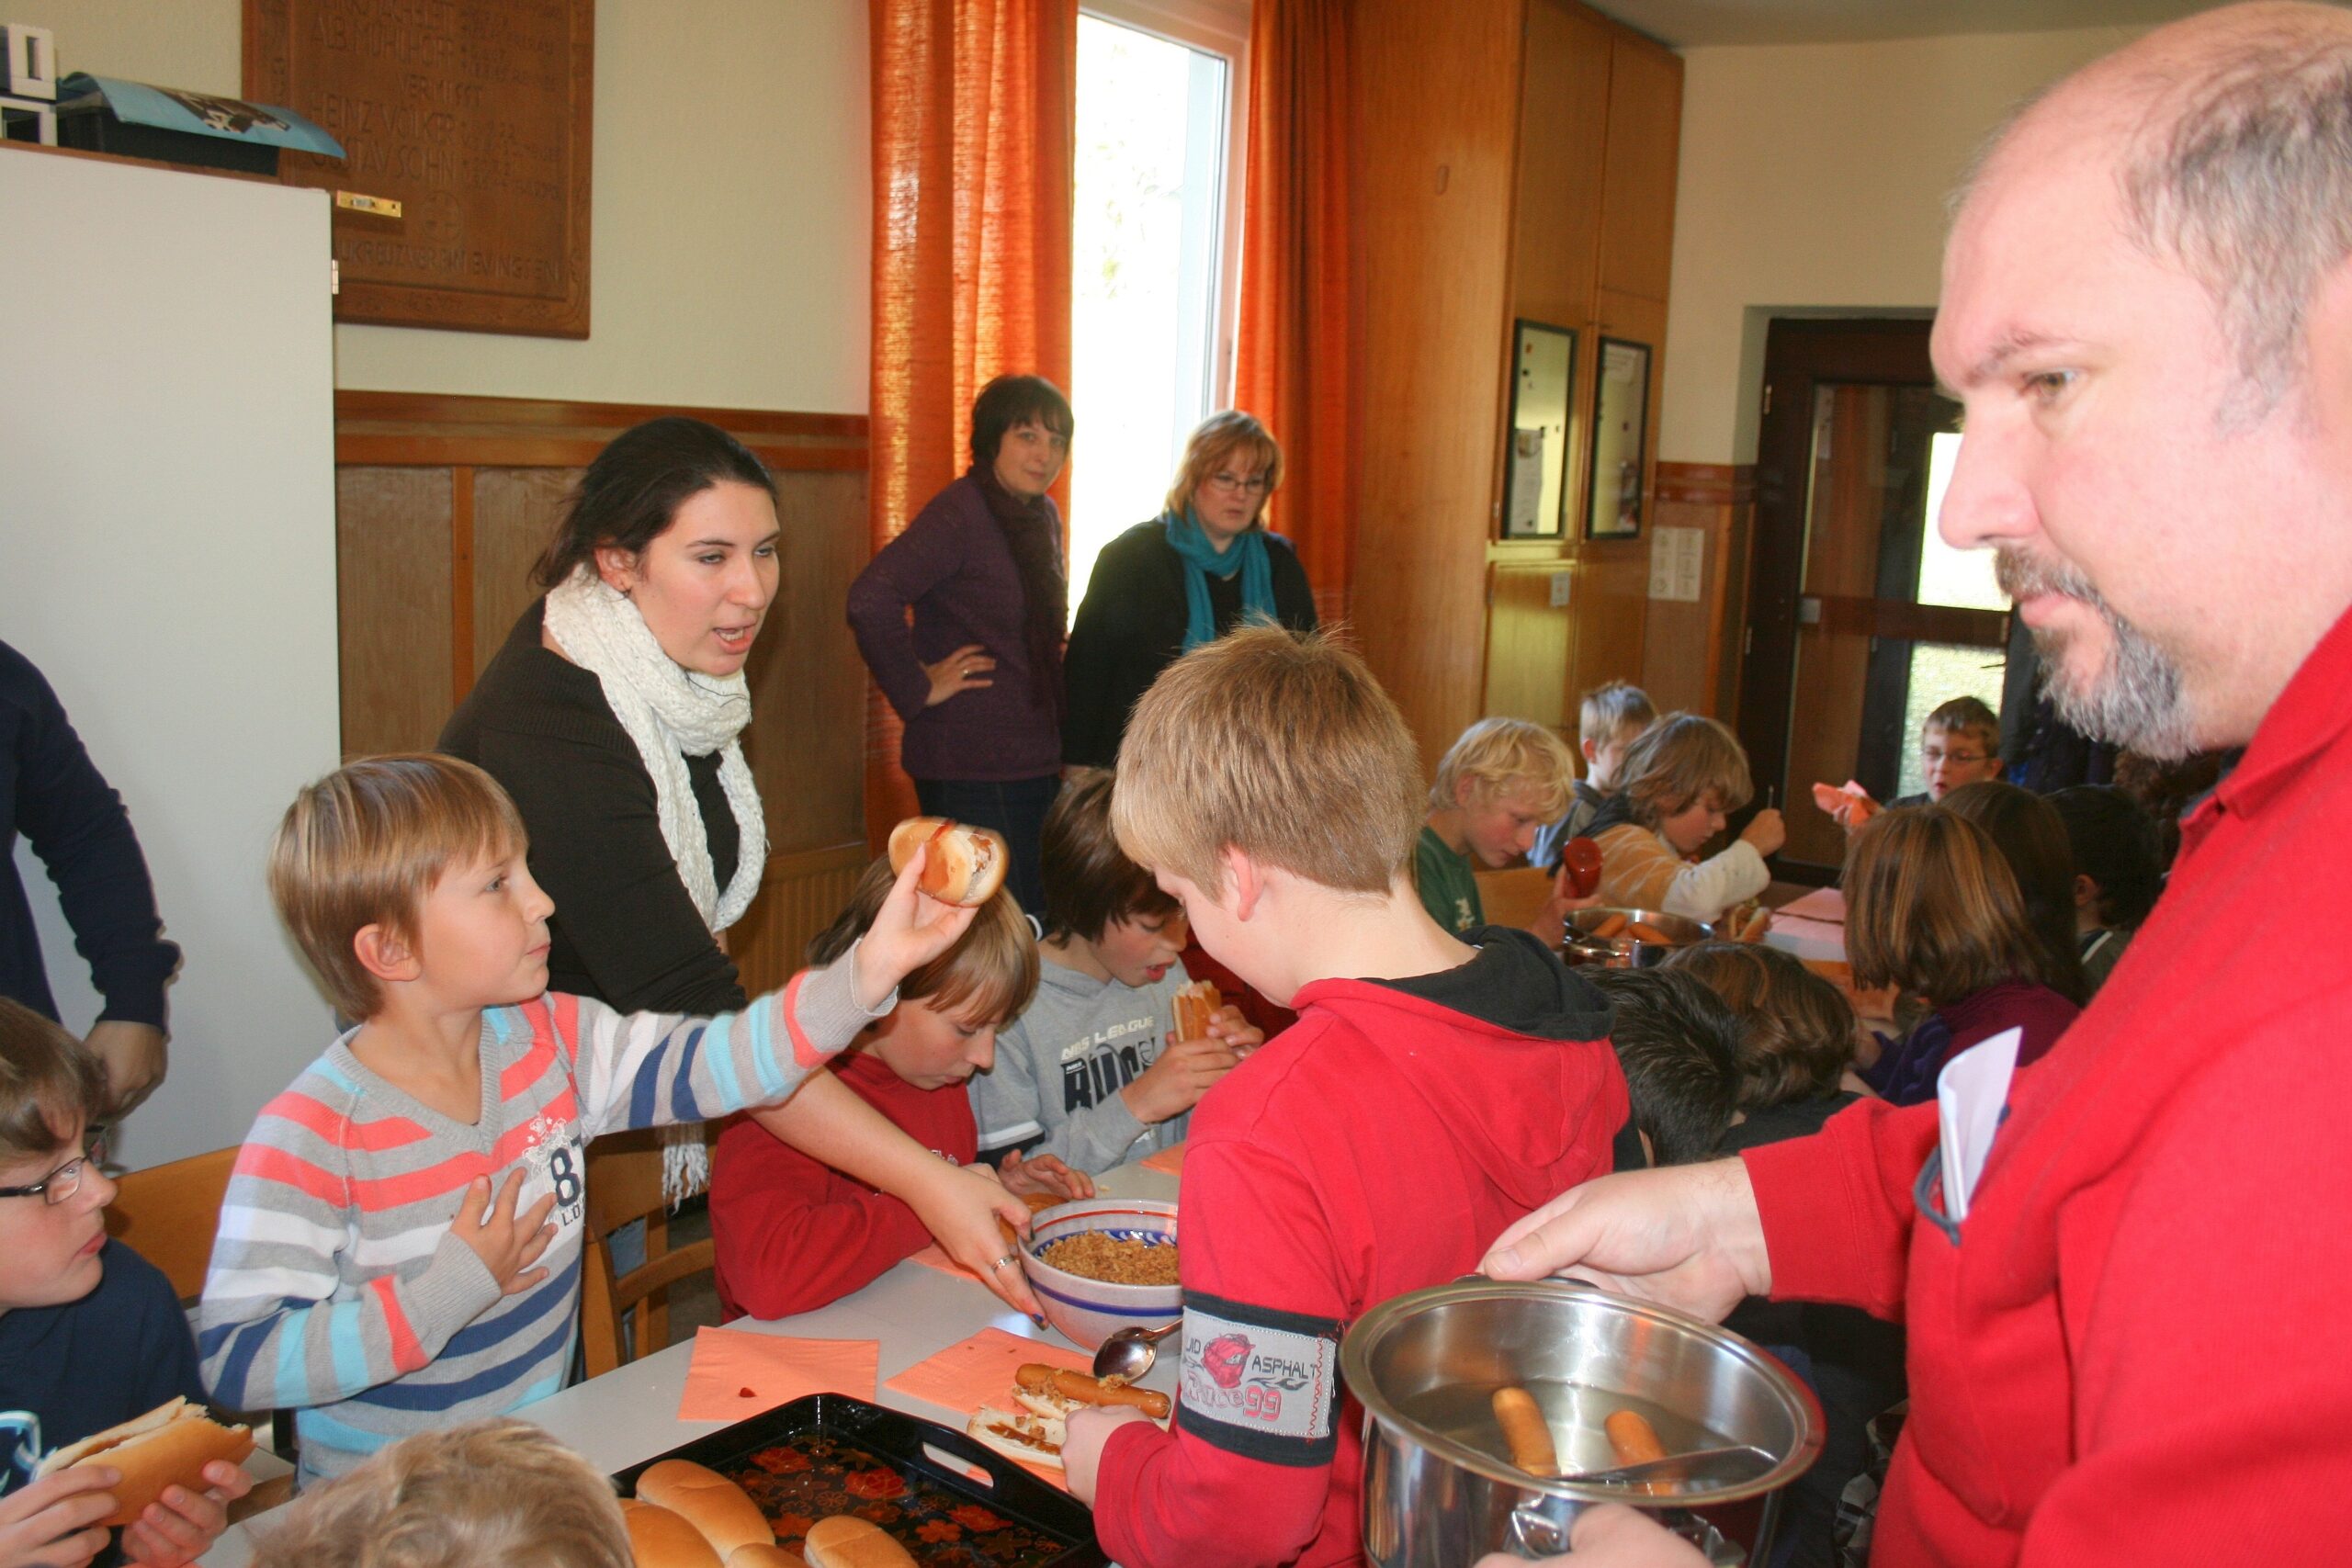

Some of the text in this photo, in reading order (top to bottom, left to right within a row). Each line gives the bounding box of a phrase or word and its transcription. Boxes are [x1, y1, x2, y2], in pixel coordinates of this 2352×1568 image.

[396, 73, 483, 108] VERMISST
[1094, 1016, 1155, 1044] LEAGUE
[550, 1147, 582, 1207] 8
[1243, 1384, 1283, 1422] 99
